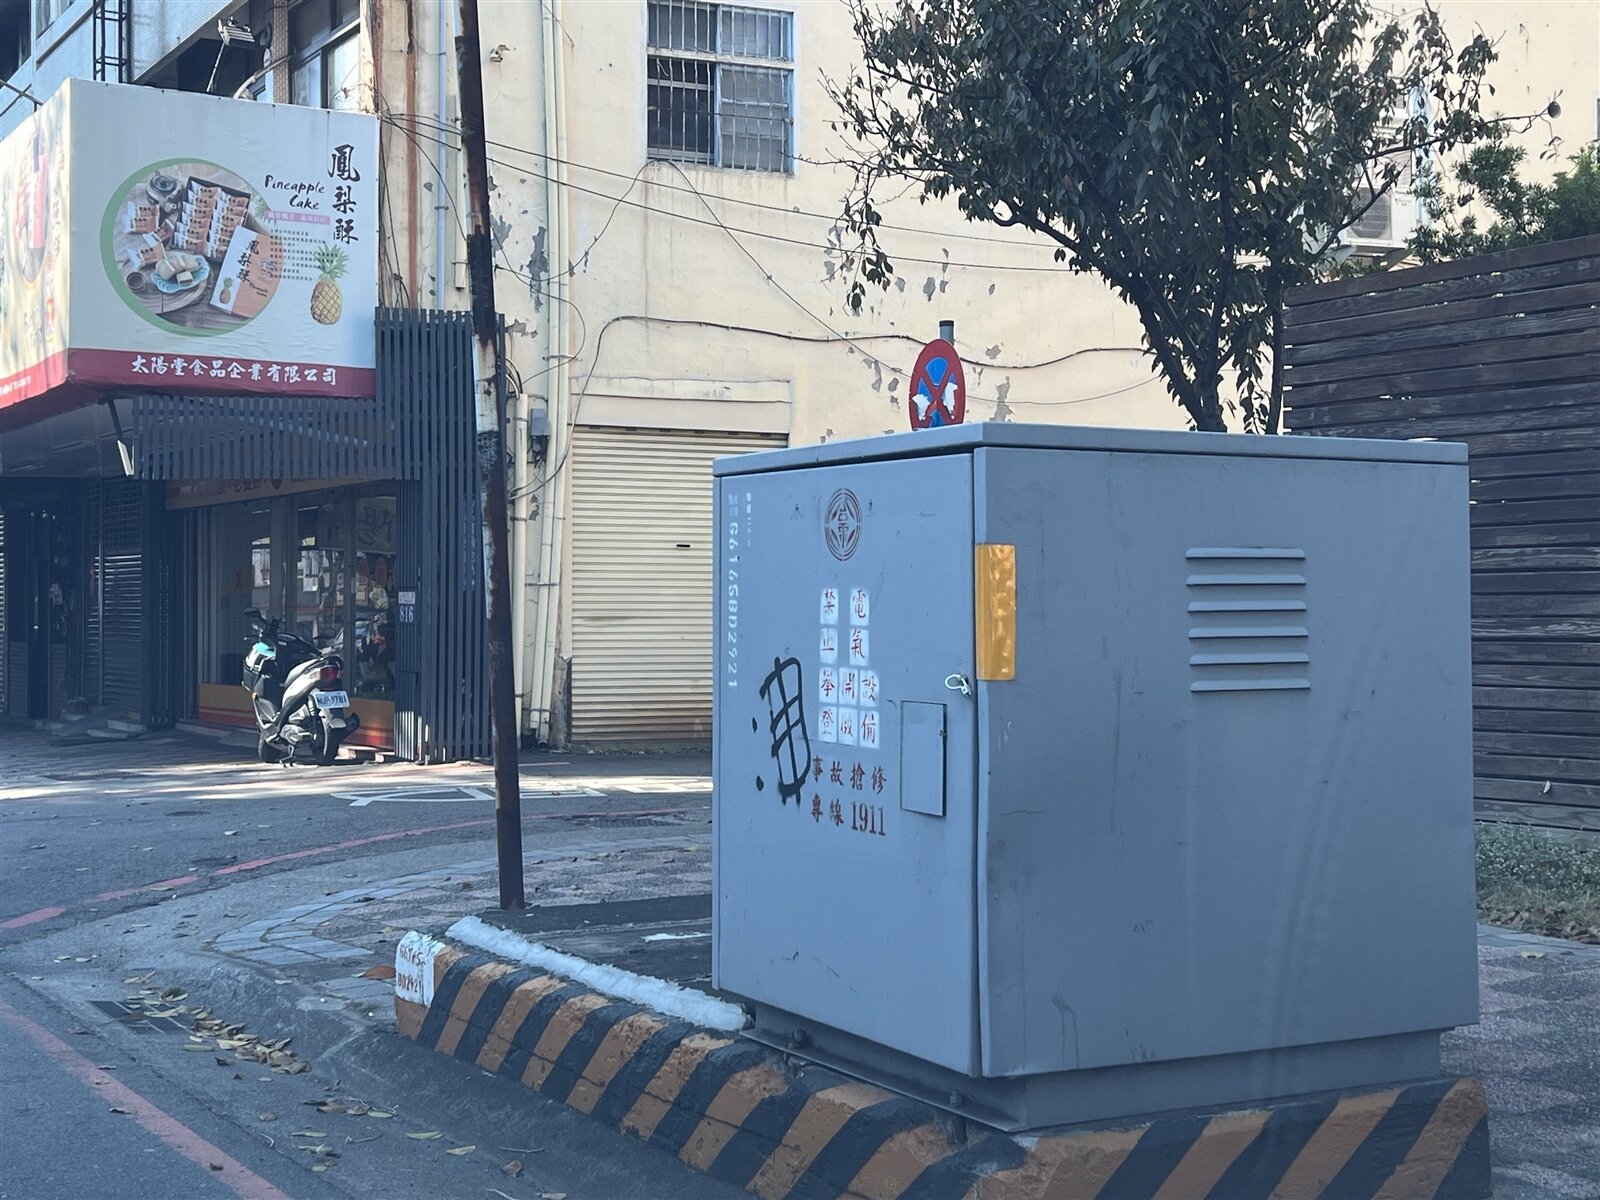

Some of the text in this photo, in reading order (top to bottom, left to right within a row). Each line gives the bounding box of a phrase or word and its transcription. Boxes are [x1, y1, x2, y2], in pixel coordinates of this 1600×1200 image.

[264, 174, 326, 195] Pineapple
[328, 144, 361, 245] 鳳梨酥
[289, 194, 320, 210] Cake
[131, 354, 337, 386] 太陽堂食品企業有限公司
[399, 605, 414, 623] 816
[812, 754, 887, 795] 事故搶修
